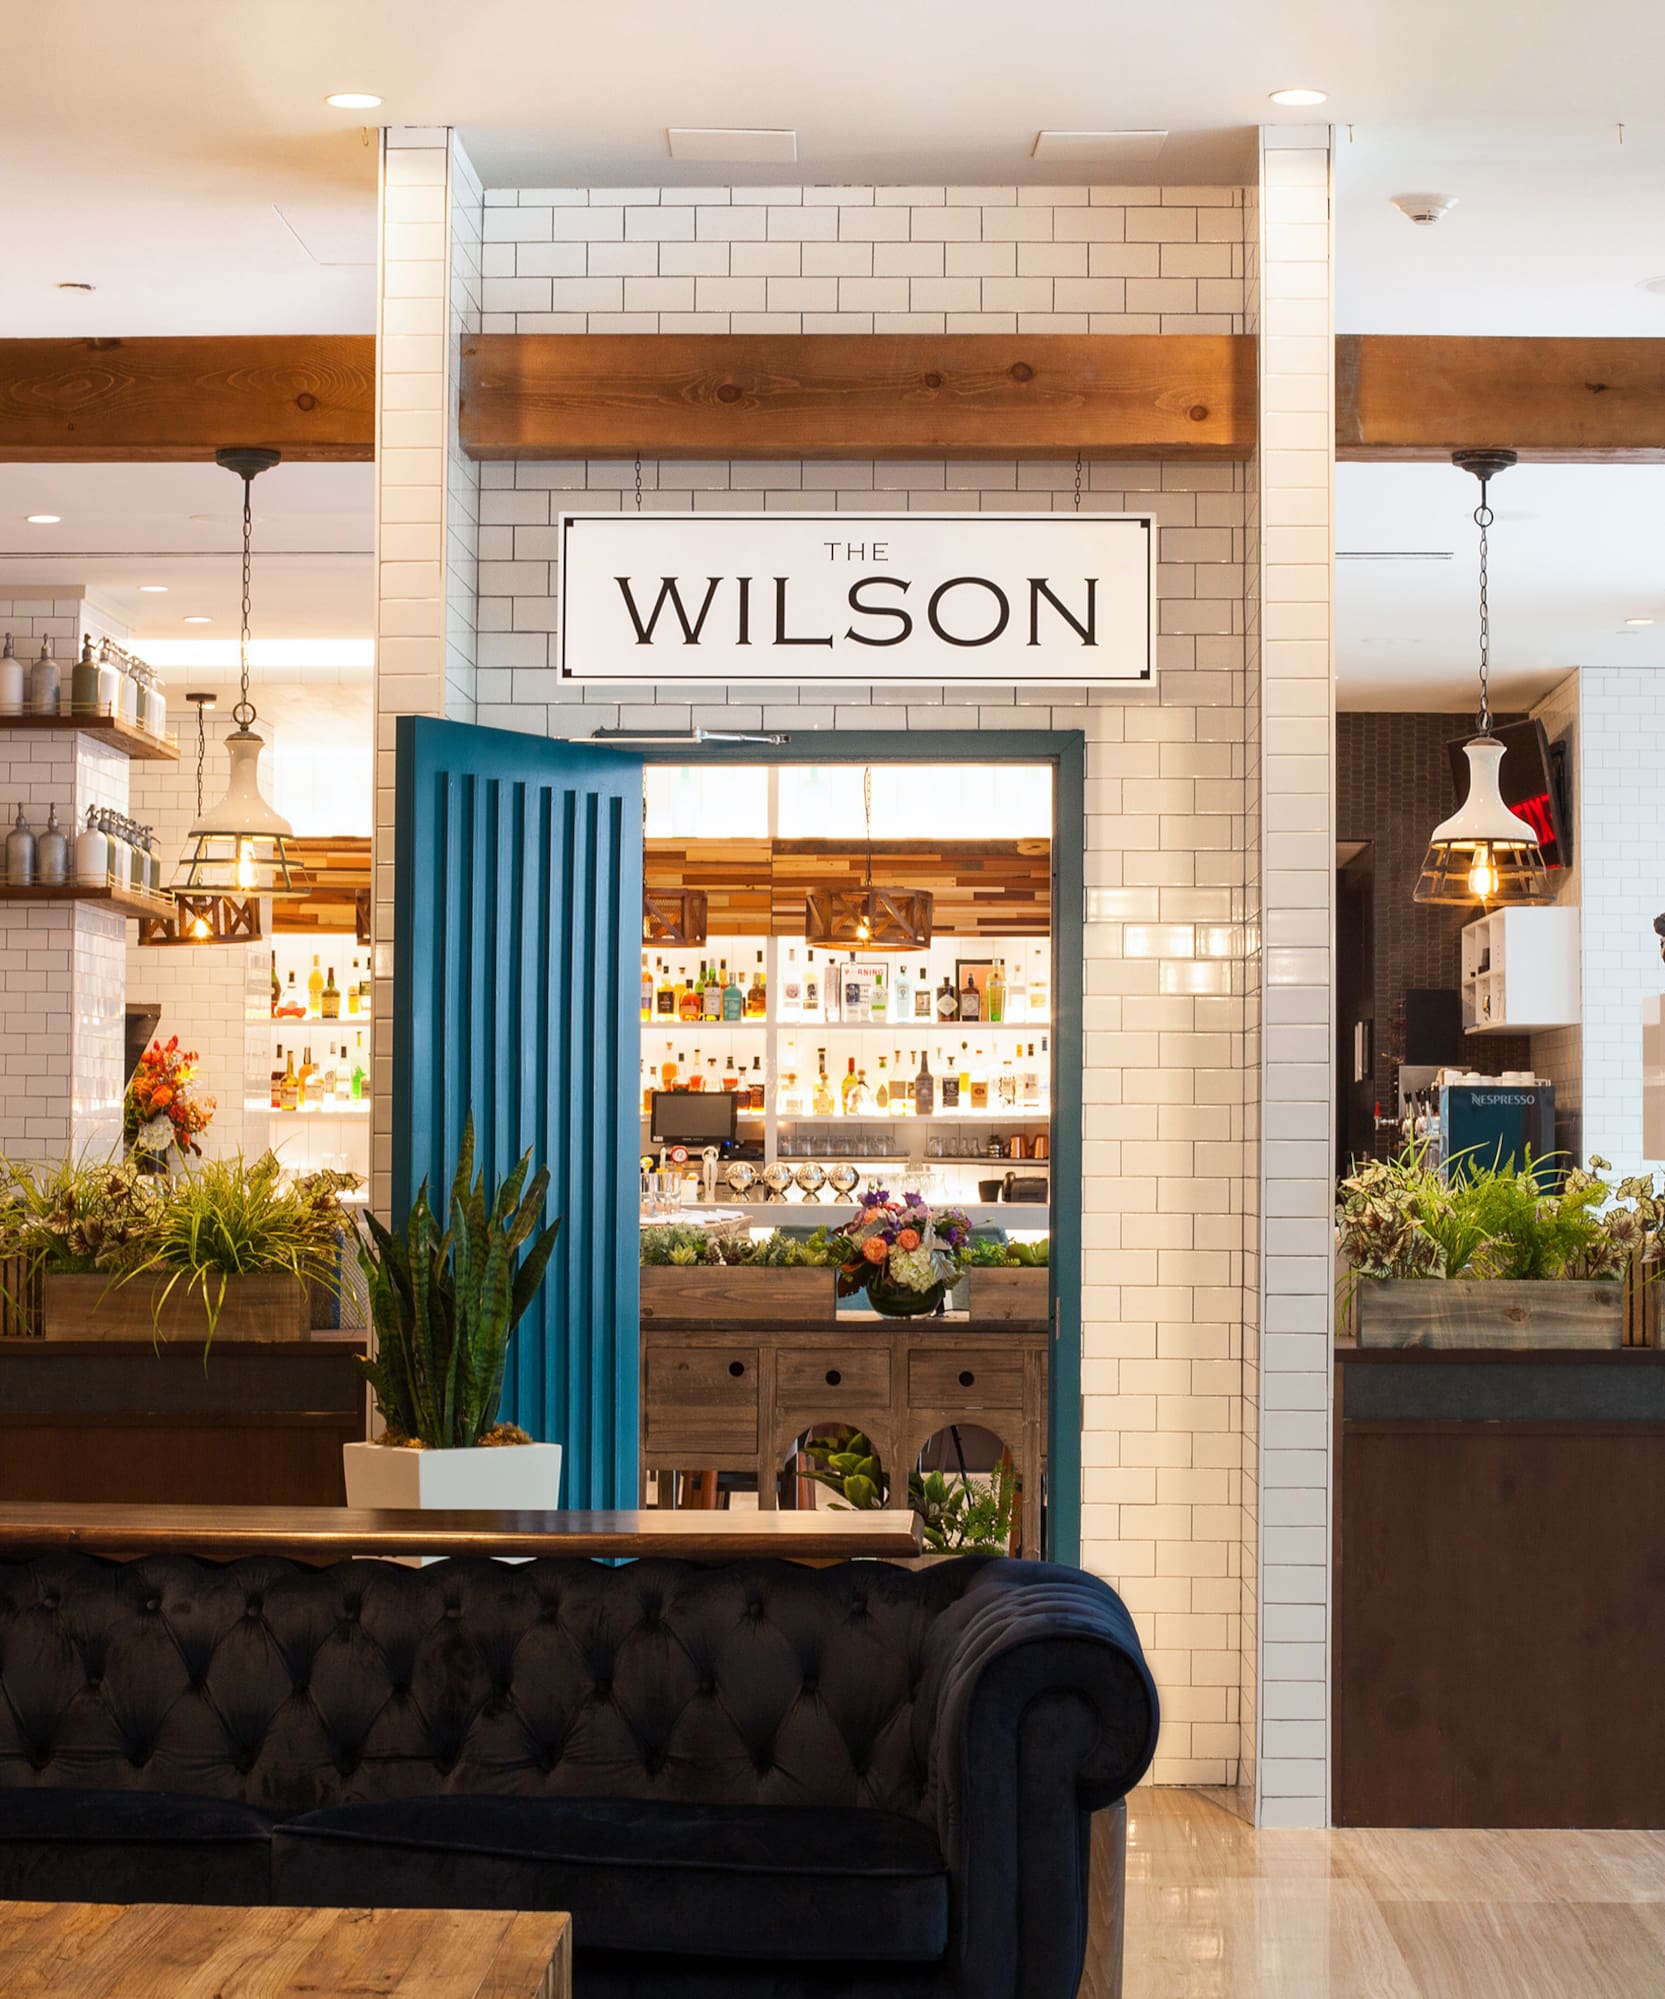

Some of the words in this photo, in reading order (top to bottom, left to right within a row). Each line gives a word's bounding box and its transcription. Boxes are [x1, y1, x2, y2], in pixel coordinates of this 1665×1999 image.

[824, 543, 889, 561] THE
[614, 576, 1099, 648] WILSON
[845, 968, 884, 976] WRNING
[1471, 1092, 1535, 1107] NESPRESSO
